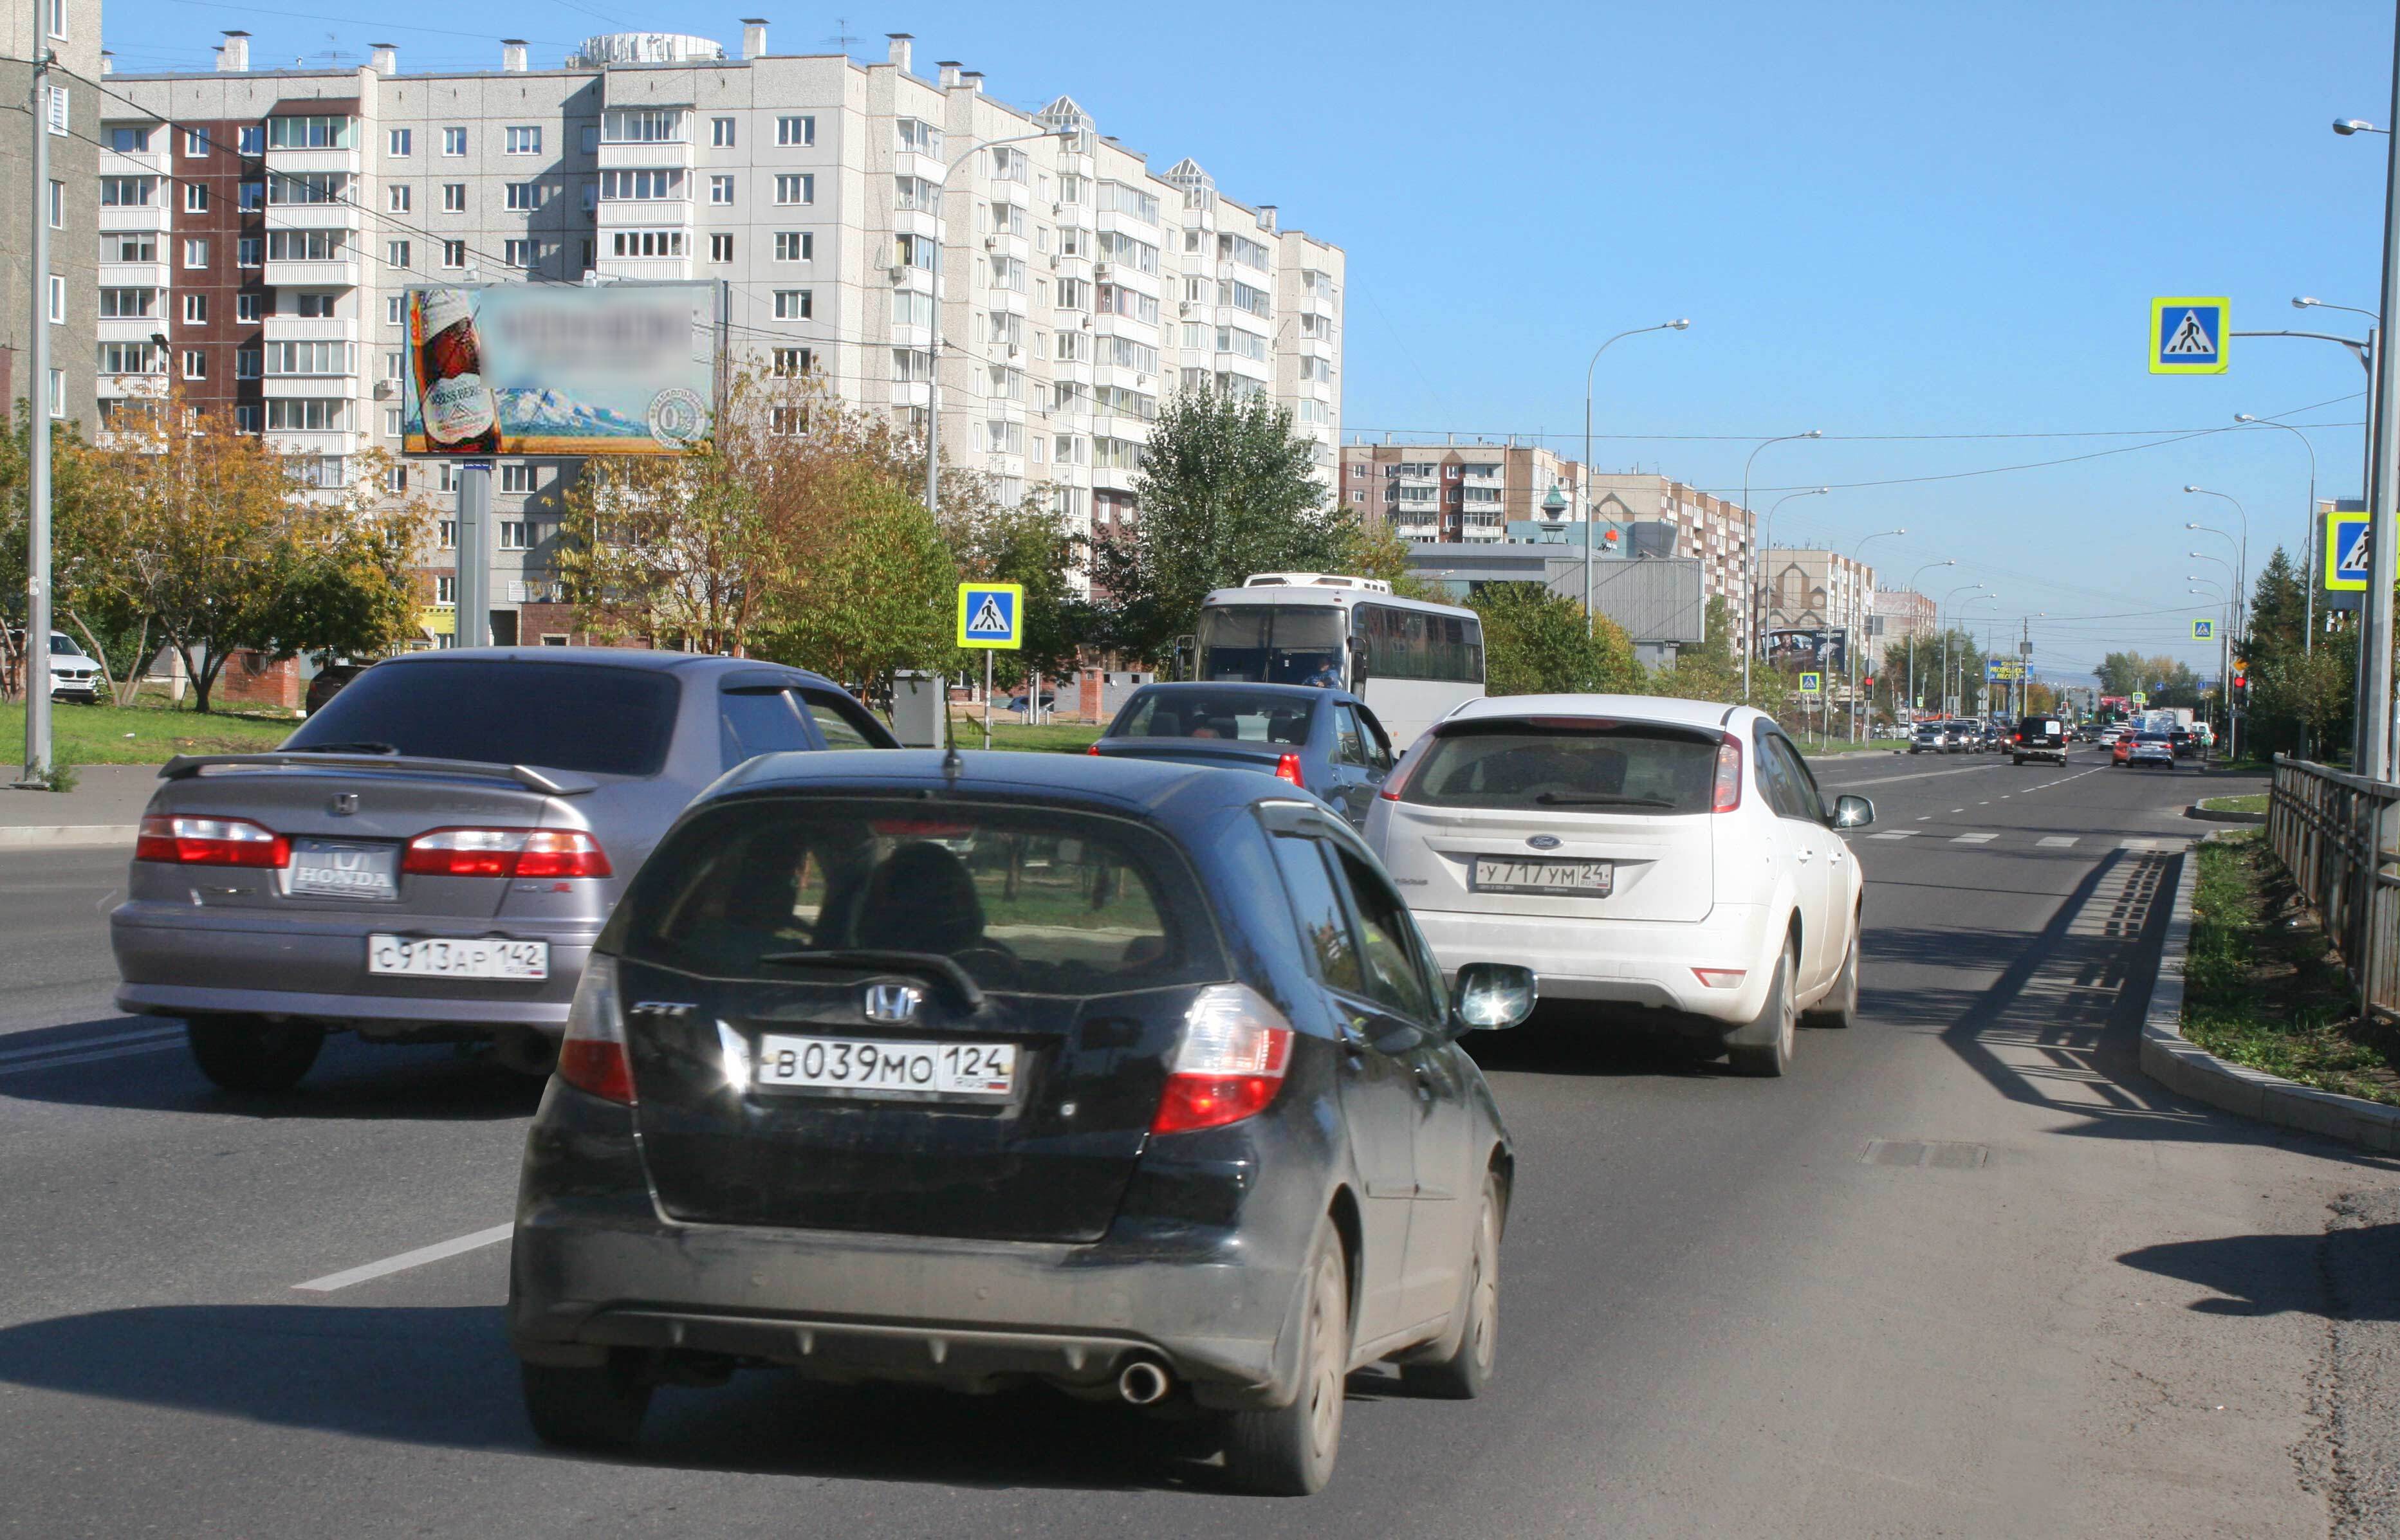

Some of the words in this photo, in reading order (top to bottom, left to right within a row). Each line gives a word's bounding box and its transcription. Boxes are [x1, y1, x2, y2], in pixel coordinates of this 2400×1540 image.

[296, 867, 393, 888] HONDA
[1486, 861, 1575, 885] У717УМ
[1582, 863, 1603, 881] 24
[378, 941, 487, 972] С913АР
[496, 944, 539, 966] 142
[776, 1043, 933, 1084] В039МО
[945, 1046, 1009, 1076] 124
[955, 1077, 986, 1088] RUS
